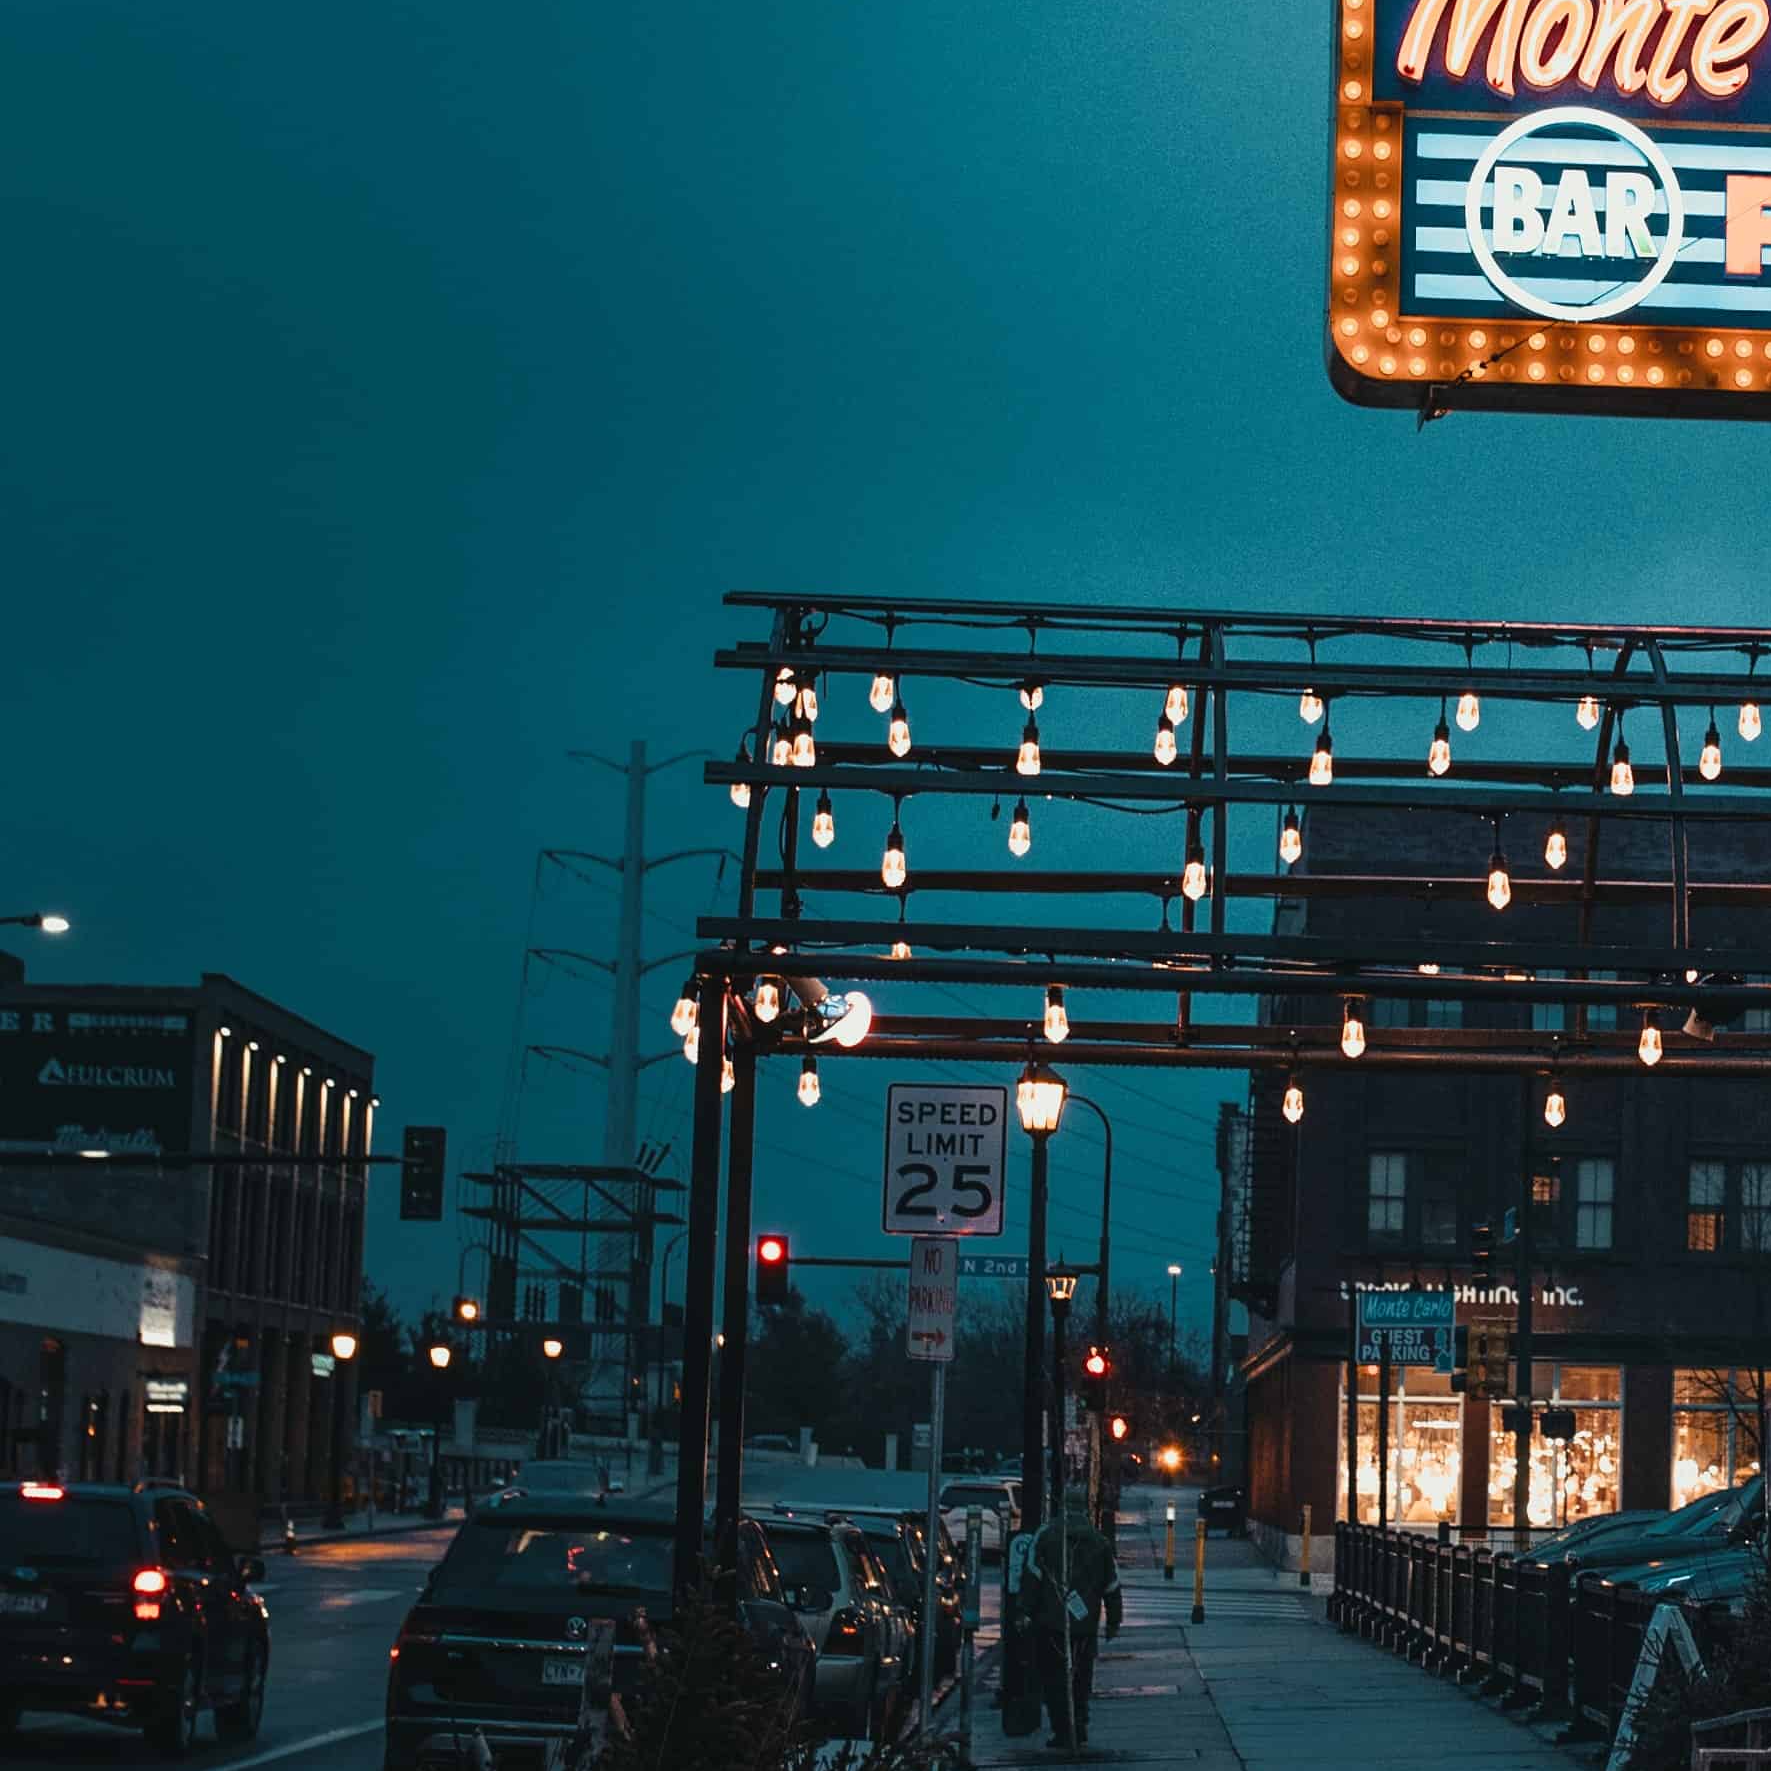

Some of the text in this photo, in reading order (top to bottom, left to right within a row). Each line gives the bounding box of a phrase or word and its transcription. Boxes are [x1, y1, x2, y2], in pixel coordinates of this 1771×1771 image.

[1493, 166, 1660, 258] BAR
[897, 1101, 998, 1127] SPEED
[907, 1132, 985, 1156] LIMIT
[895, 1162, 993, 1218] 25
[924, 1247, 943, 1276] NO
[963, 1260, 977, 1274] N
[983, 1258, 1018, 1274] 2nd
[1365, 1295, 1452, 1319] Monte Carlo
[1361, 1344, 1430, 1361] PAKING
